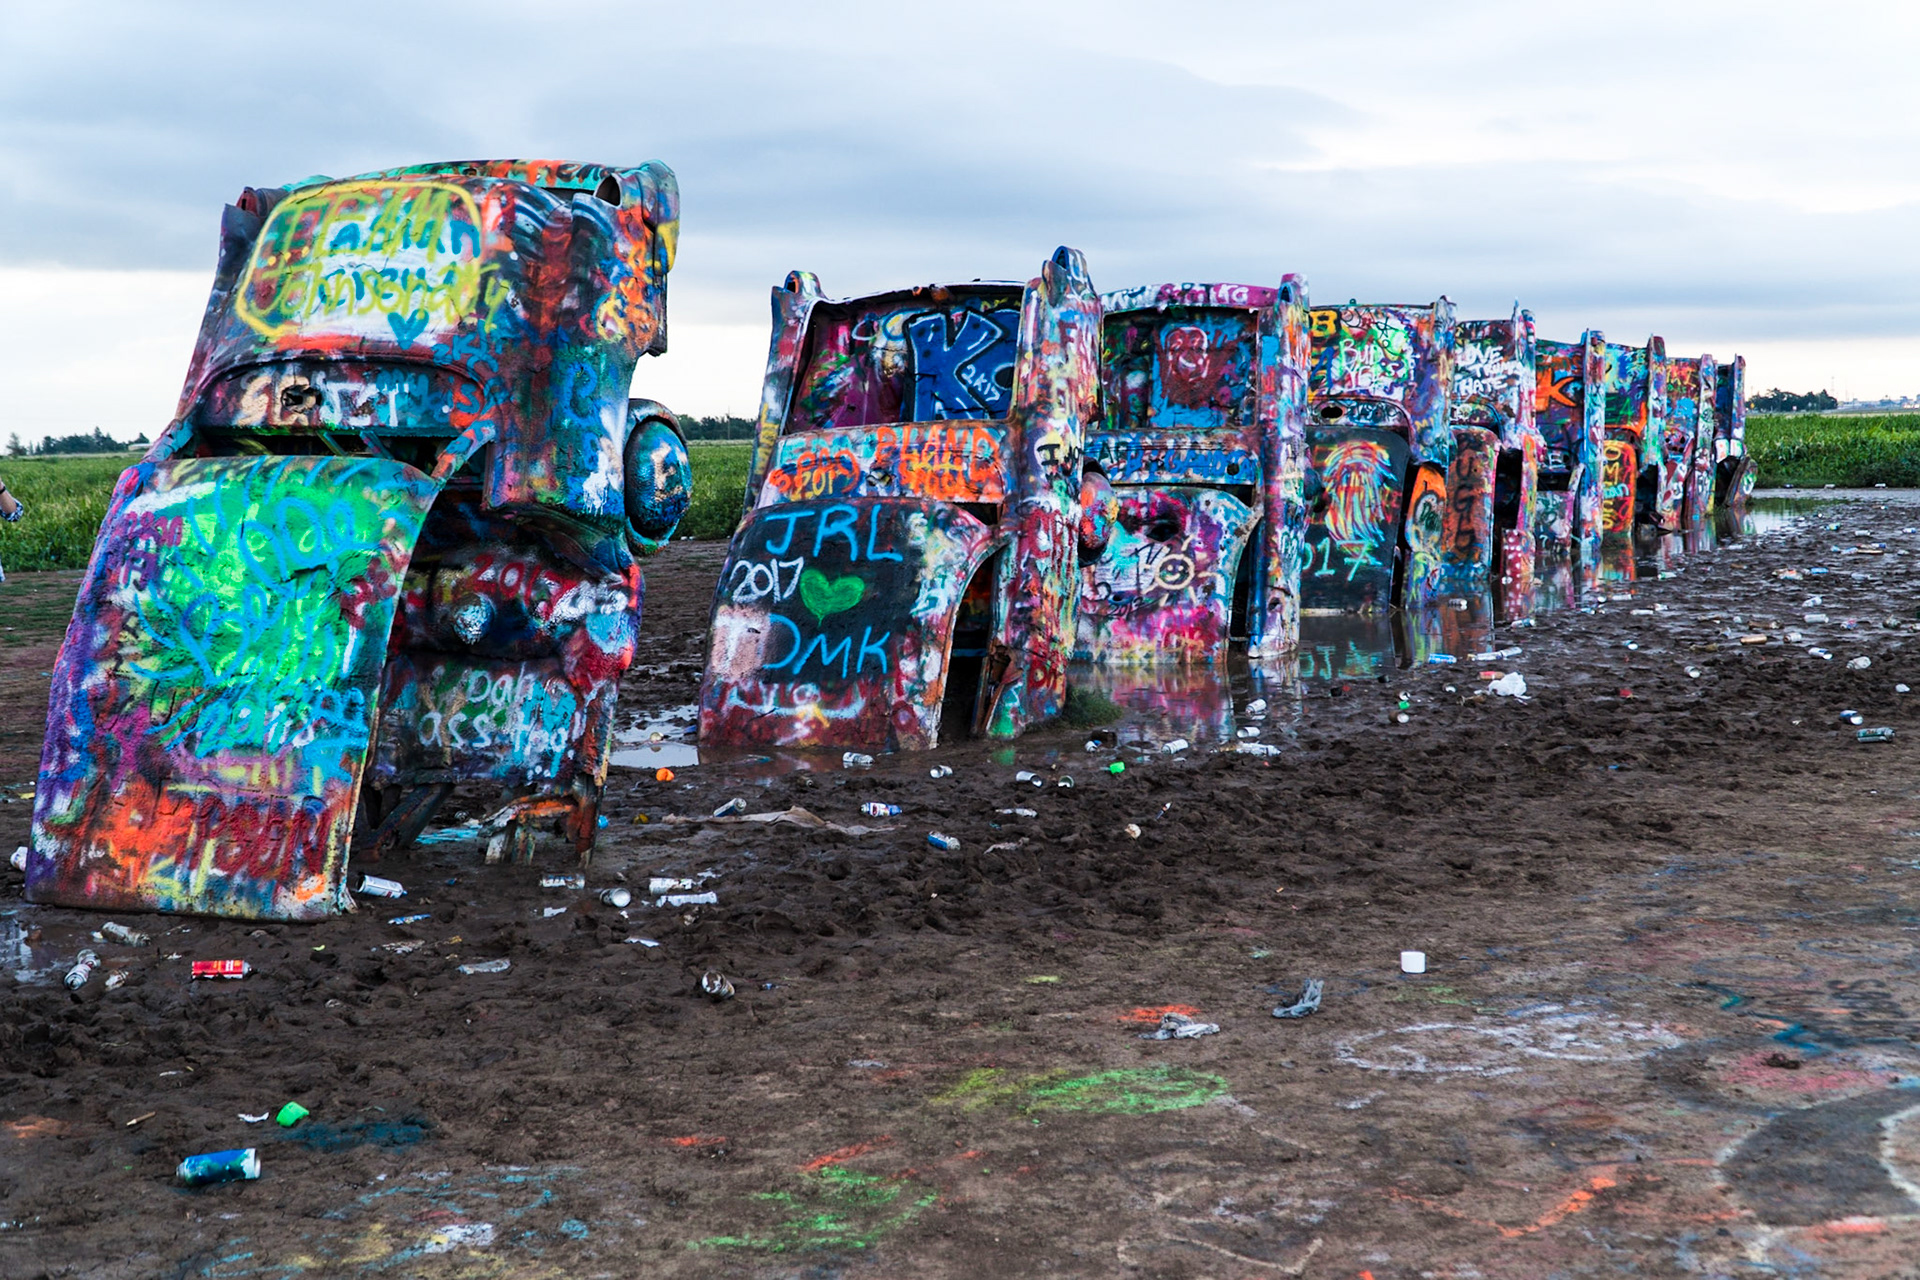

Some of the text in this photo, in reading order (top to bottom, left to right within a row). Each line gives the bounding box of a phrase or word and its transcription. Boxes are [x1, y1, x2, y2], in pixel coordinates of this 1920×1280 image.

[961, 364, 1001, 402] 2K17
[873, 424, 1000, 480] BLAND
[764, 504, 903, 562] JRL
[729, 556, 804, 603] 2017
[763, 612, 891, 679] DMK
